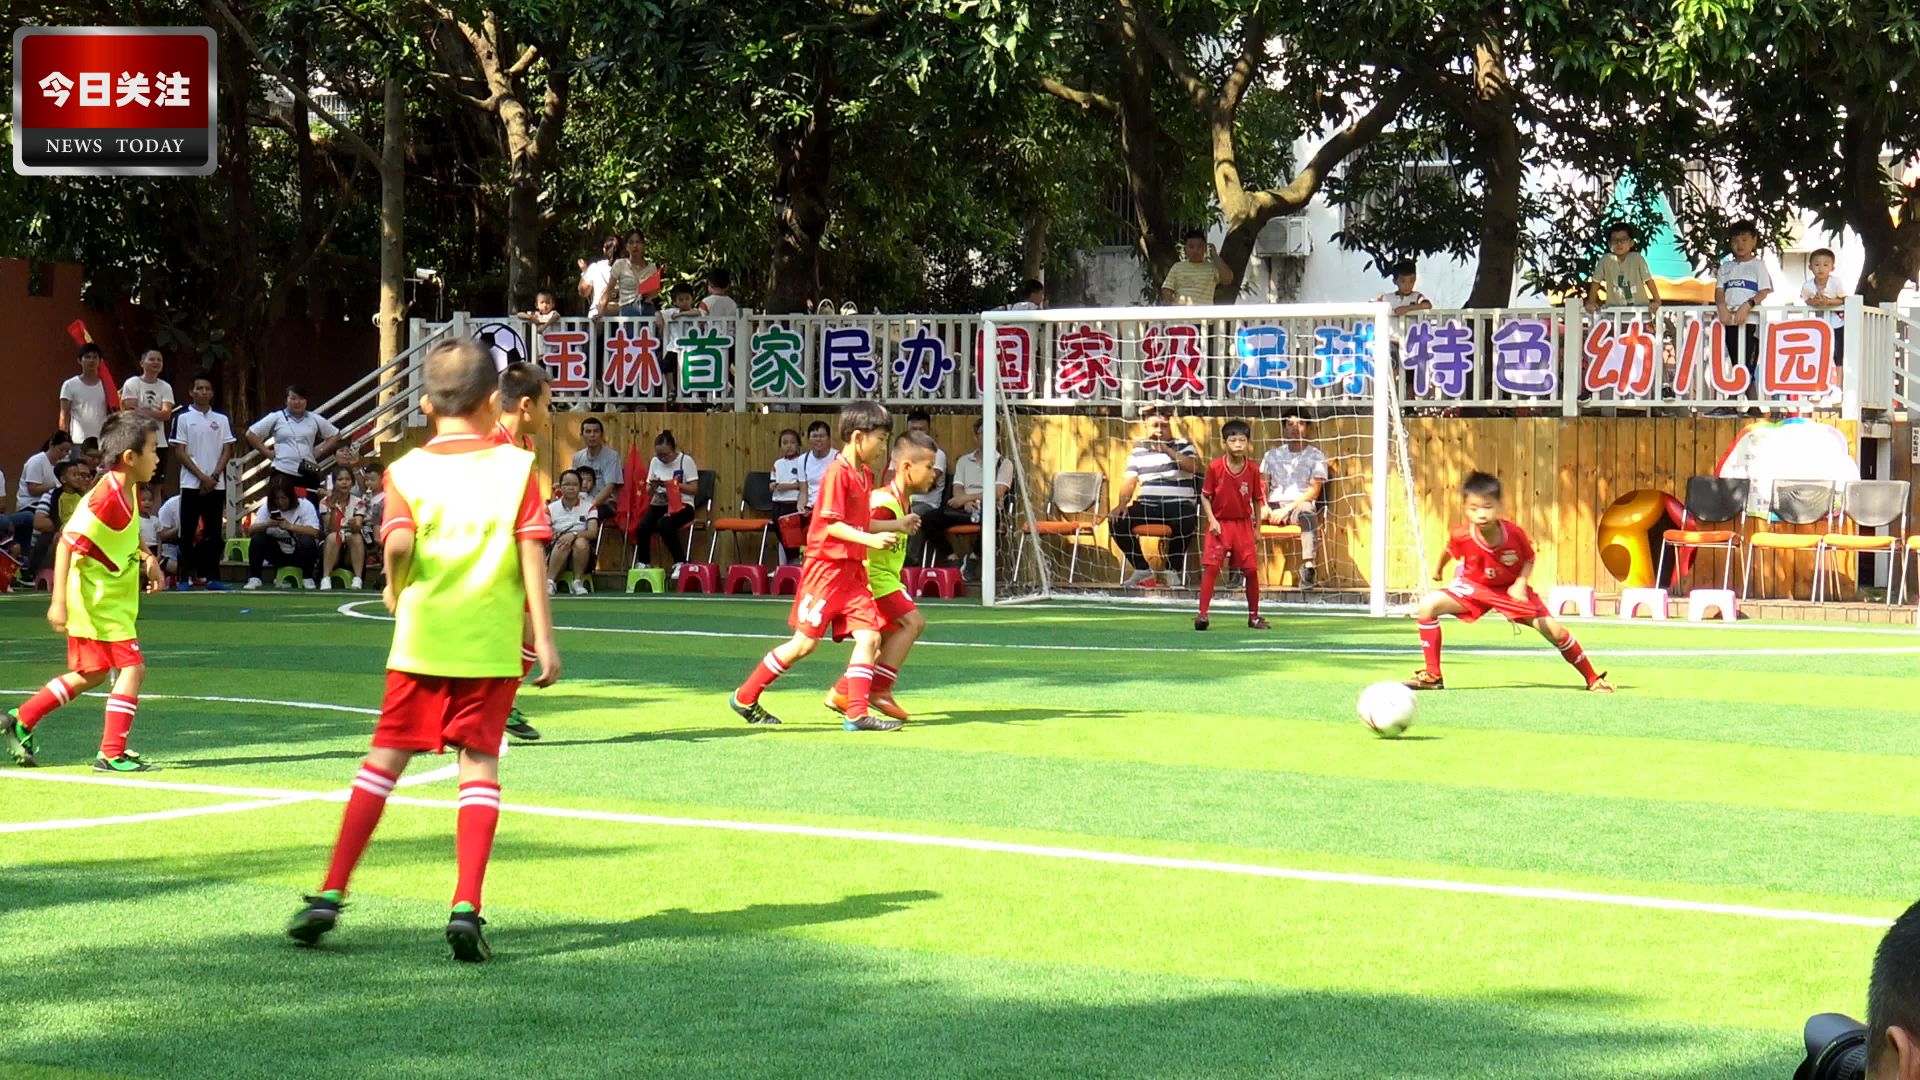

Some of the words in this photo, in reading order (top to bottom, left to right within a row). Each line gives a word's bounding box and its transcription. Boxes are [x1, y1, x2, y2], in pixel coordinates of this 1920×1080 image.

[543, 319, 1833, 396] 玉林首家民办国家级足球特色幼儿园
